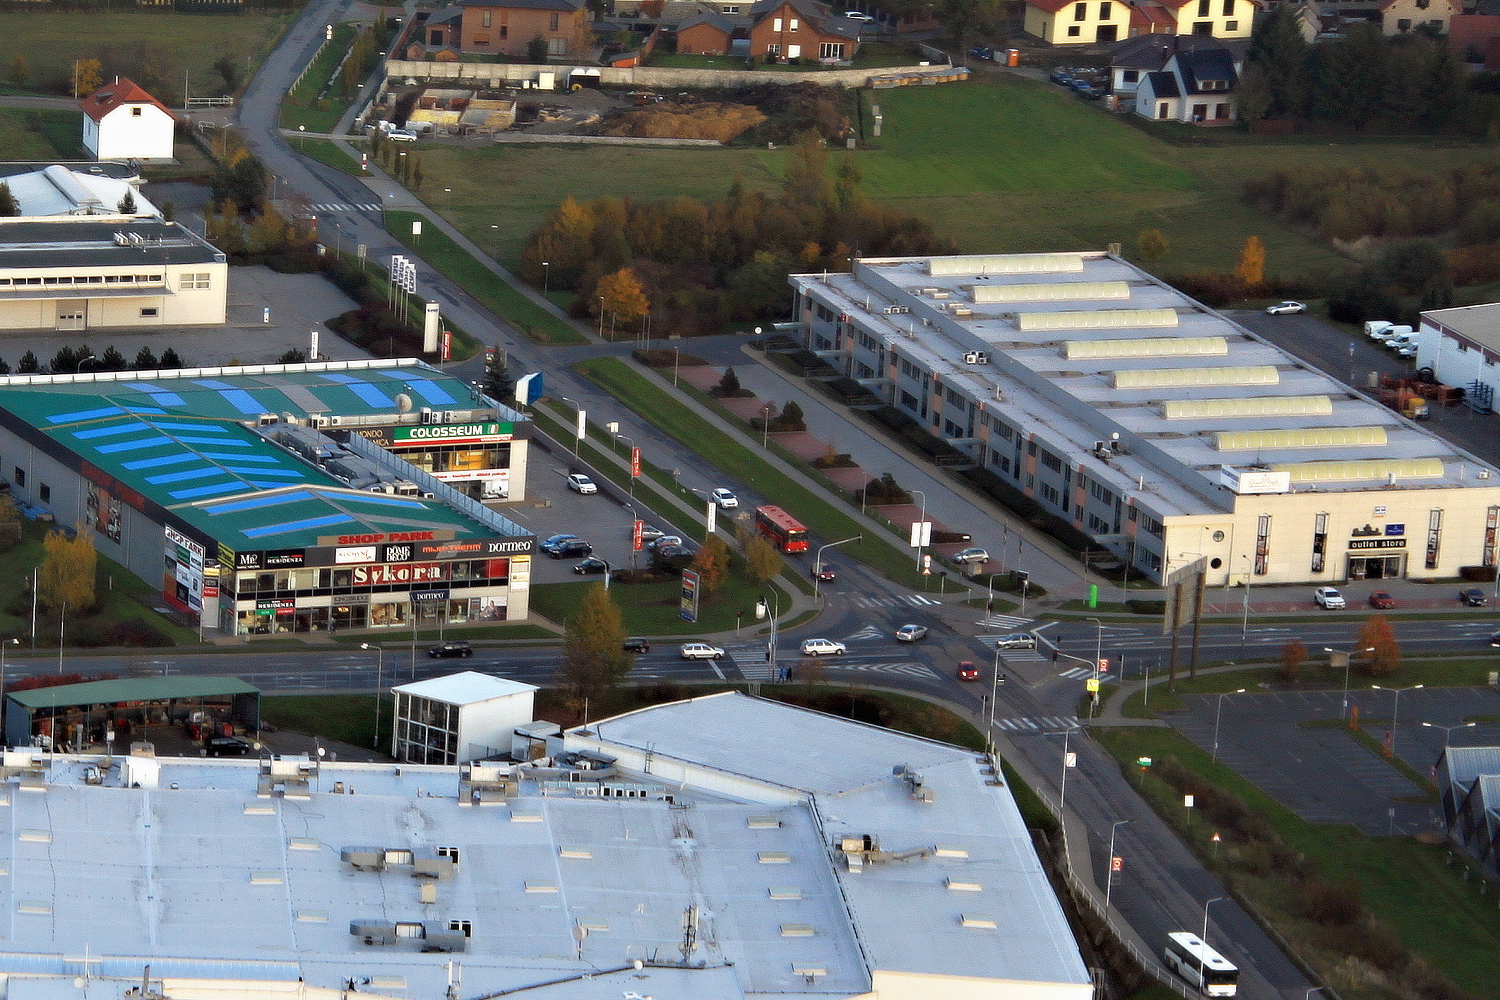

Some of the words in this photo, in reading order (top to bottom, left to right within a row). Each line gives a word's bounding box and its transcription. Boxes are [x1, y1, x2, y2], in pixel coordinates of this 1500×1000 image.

[409, 424, 483, 438] COLOSSEUM
[337, 533, 385, 545] SHOP
[389, 530, 435, 542] PARK
[1351, 540, 1378, 548] outlet
[353, 565, 441, 585] Sykora
